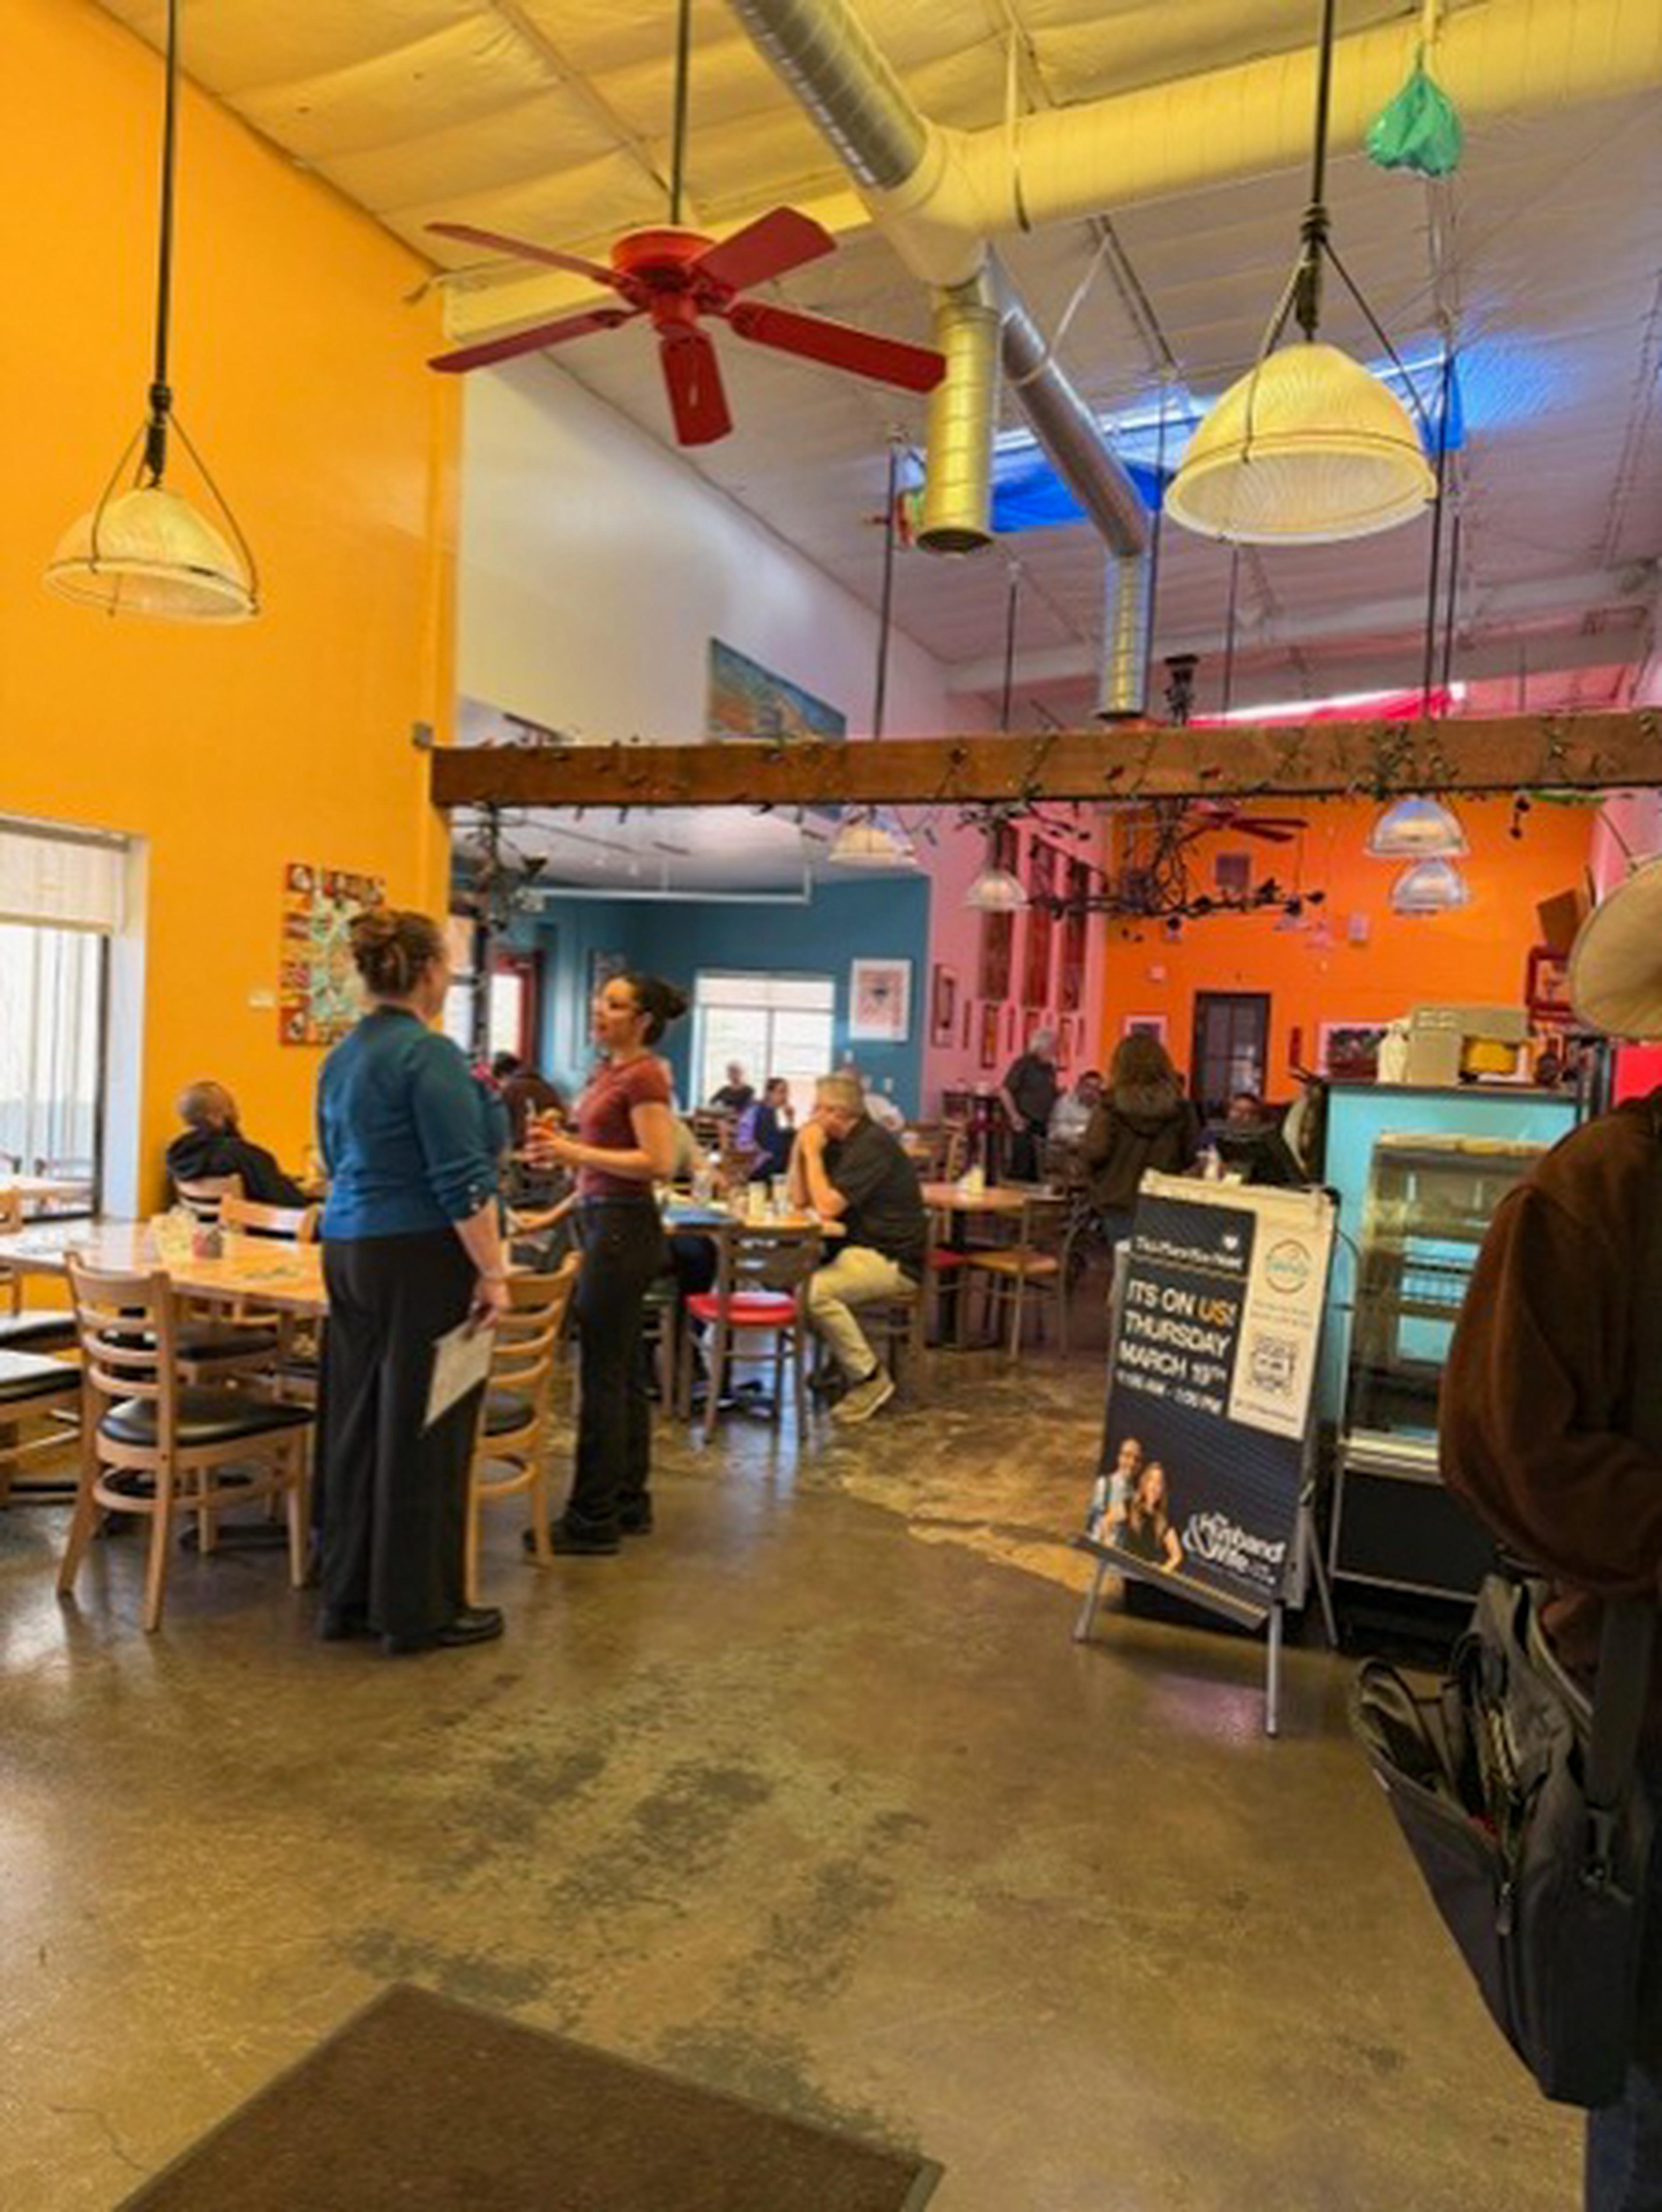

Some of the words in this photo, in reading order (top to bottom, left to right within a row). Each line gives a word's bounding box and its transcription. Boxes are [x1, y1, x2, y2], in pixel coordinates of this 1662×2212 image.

[1161, 1288, 1196, 1316] ON
[1199, 1296, 1237, 1327] US!
[1125, 1310, 1232, 1358] THURSDAY
[1119, 1340, 1188, 1378] MARCH
